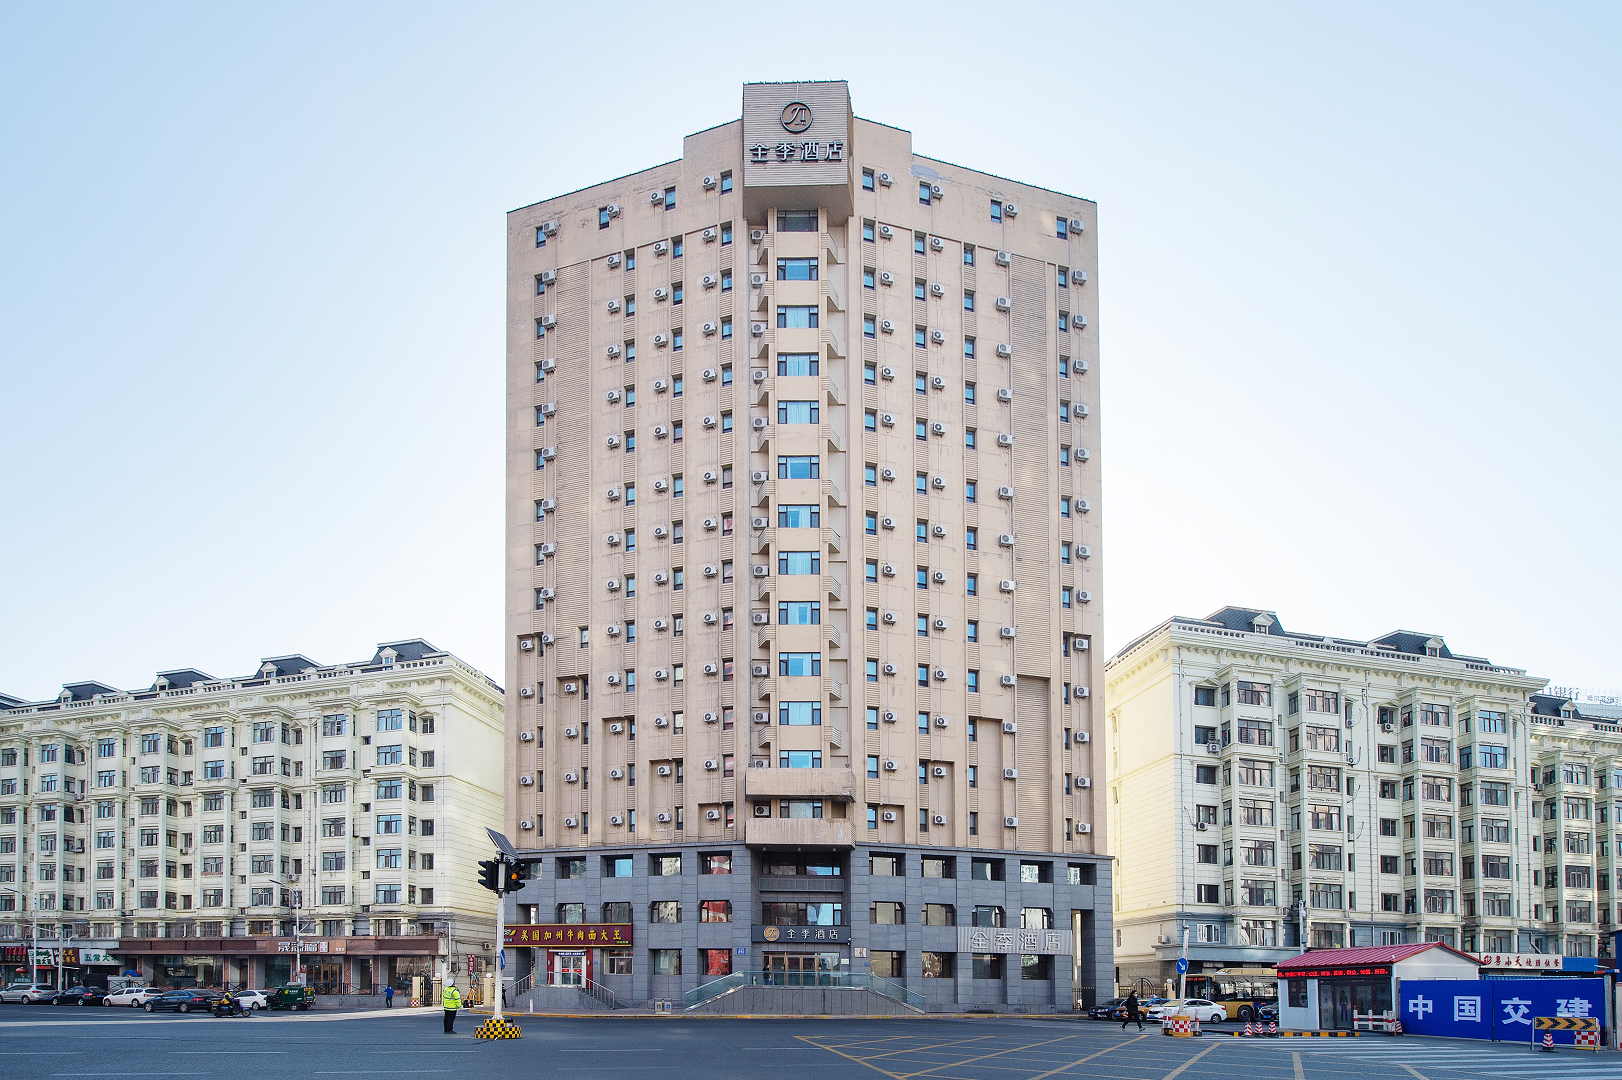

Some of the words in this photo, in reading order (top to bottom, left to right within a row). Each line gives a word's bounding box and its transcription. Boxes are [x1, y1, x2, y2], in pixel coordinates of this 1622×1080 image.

[750, 140, 843, 162] 全季酒店
[520, 929, 622, 942] 美国加州牛肉面大王
[786, 928, 839, 940] 全季酒店
[969, 931, 1062, 951] 全季酒店
[1408, 994, 1593, 1026] 中国交建
